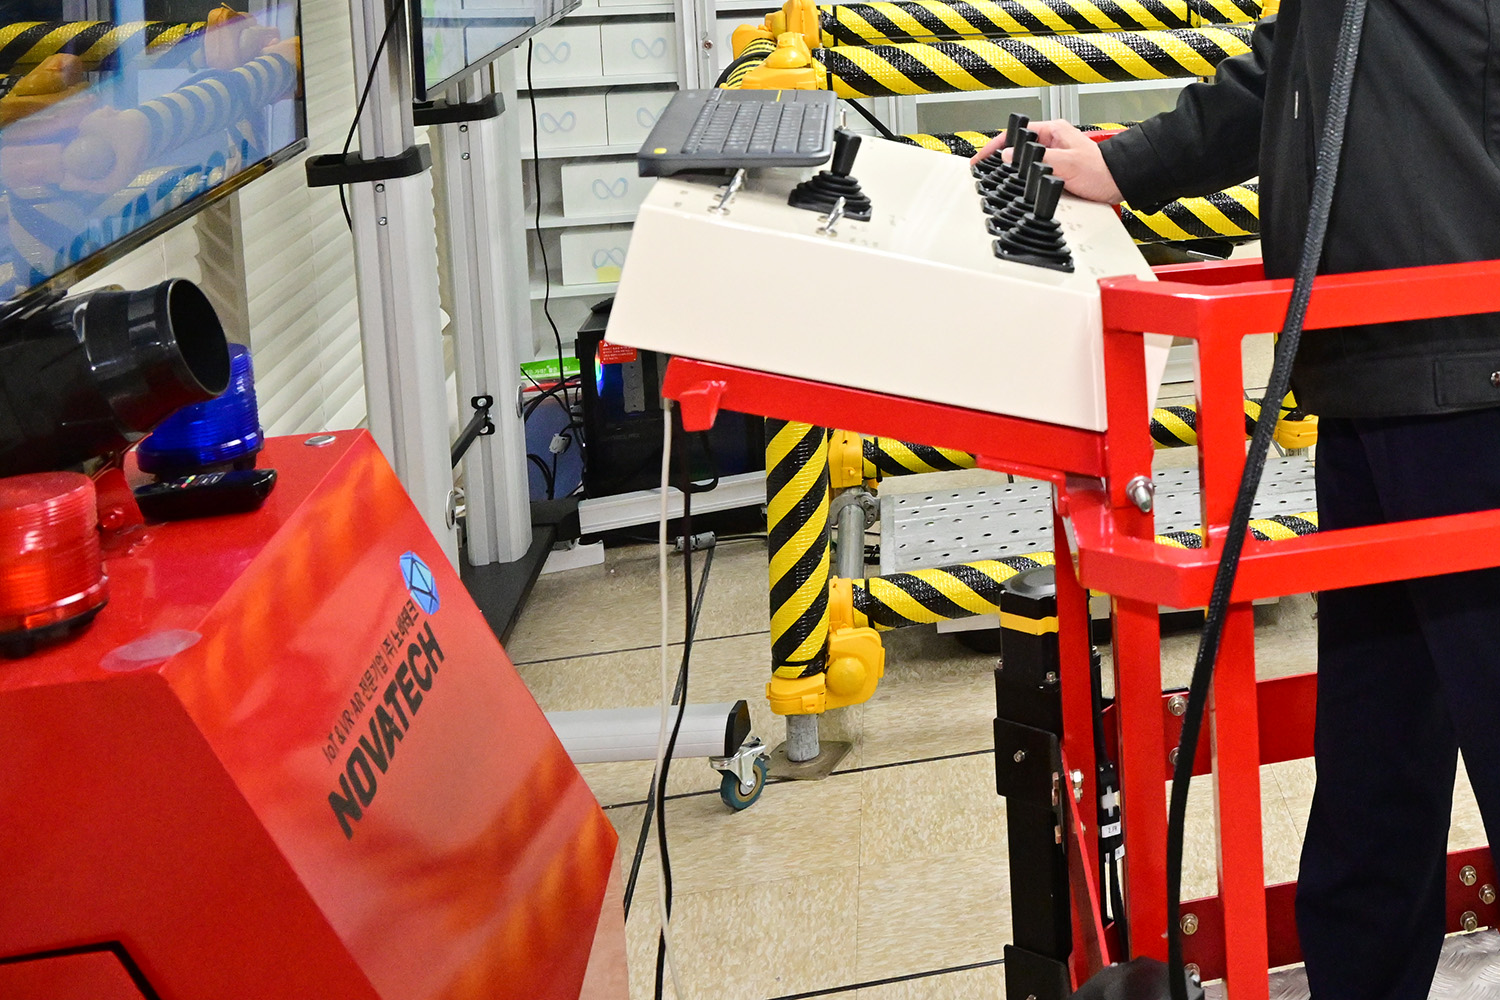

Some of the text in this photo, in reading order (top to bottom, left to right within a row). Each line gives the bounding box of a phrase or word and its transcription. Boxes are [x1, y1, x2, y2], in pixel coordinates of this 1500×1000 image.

[323, 733, 340, 765] IoT
[335, 723, 346, 745] &
[359, 653, 389, 700] 전문기업
[328, 621, 445, 841] NOVATECH
